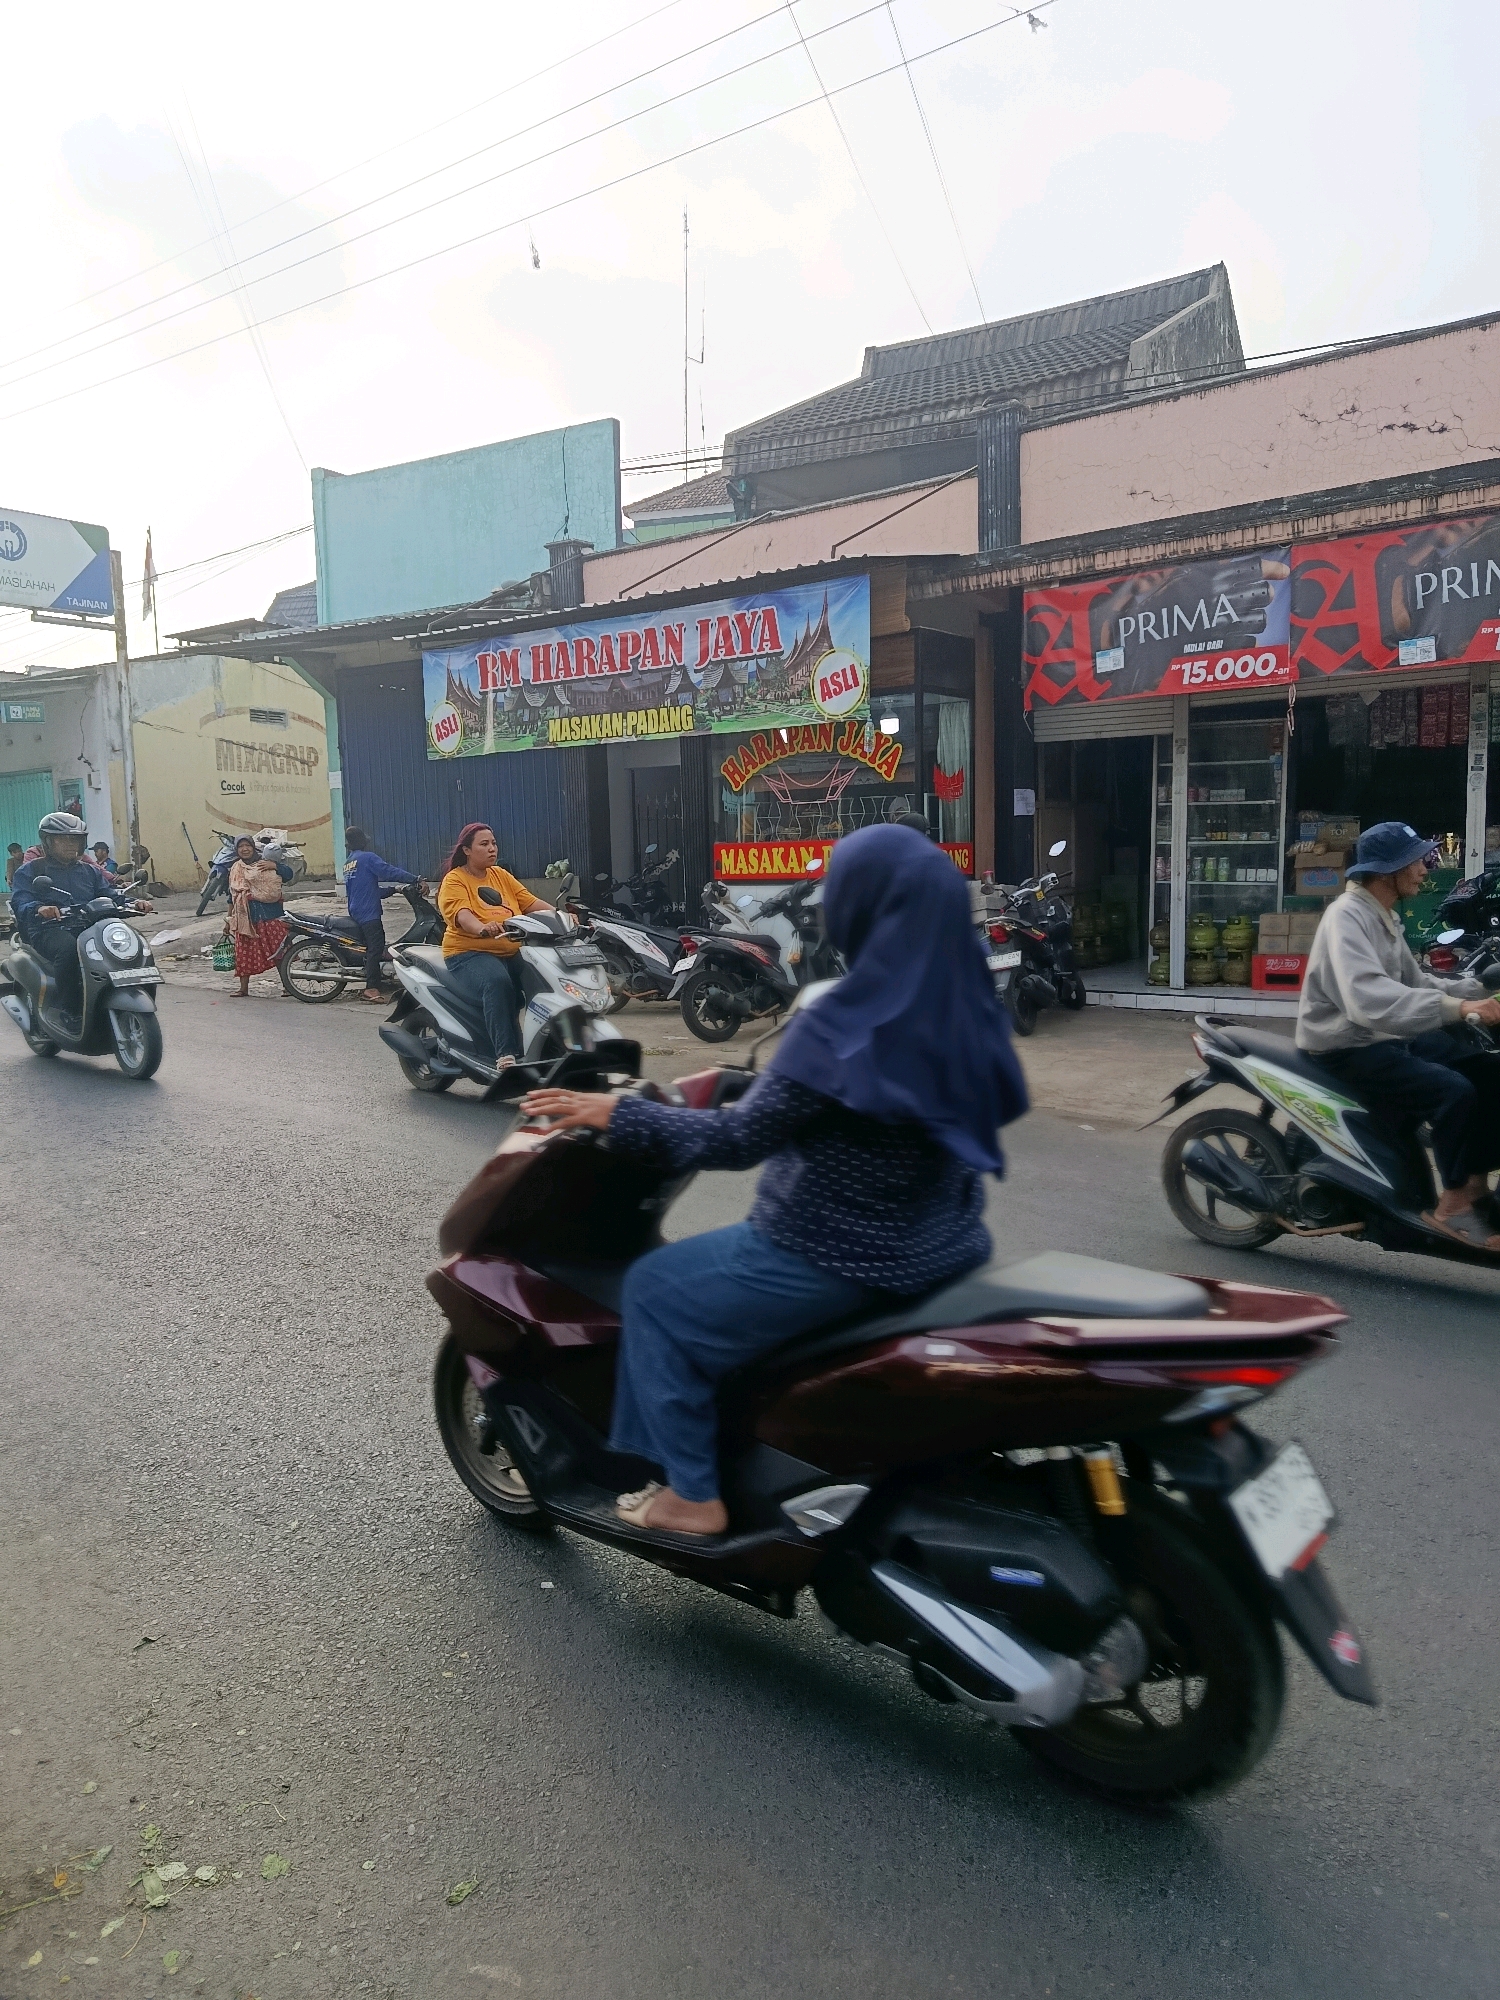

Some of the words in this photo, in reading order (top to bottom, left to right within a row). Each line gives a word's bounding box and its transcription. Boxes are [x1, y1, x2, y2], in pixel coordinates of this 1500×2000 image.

[66, 596, 108, 610] TAJINAN
[1118, 593, 1240, 648] PRIMA
[476, 646, 522, 692] RM
[530, 621, 685, 683] HARAPAN
[694, 607, 783, 667] JAYA
[1184, 642, 1206, 654] MULAI
[1207, 639, 1224, 651] DARI
[819, 662, 860, 702] ASLI
[434, 713, 459, 744] ASLI
[548, 712, 623, 742] MASAKAN
[626, 704, 694, 737] PADANG
[215, 738, 319, 777] MIXAGRIP
[721, 723, 835, 791] HARAPAN
[838, 721, 902, 781] JAYA
[220, 780, 246, 793] Cocok
[1330, 828, 1348, 836] TOP
[720, 846, 815, 875] MASAKAN
